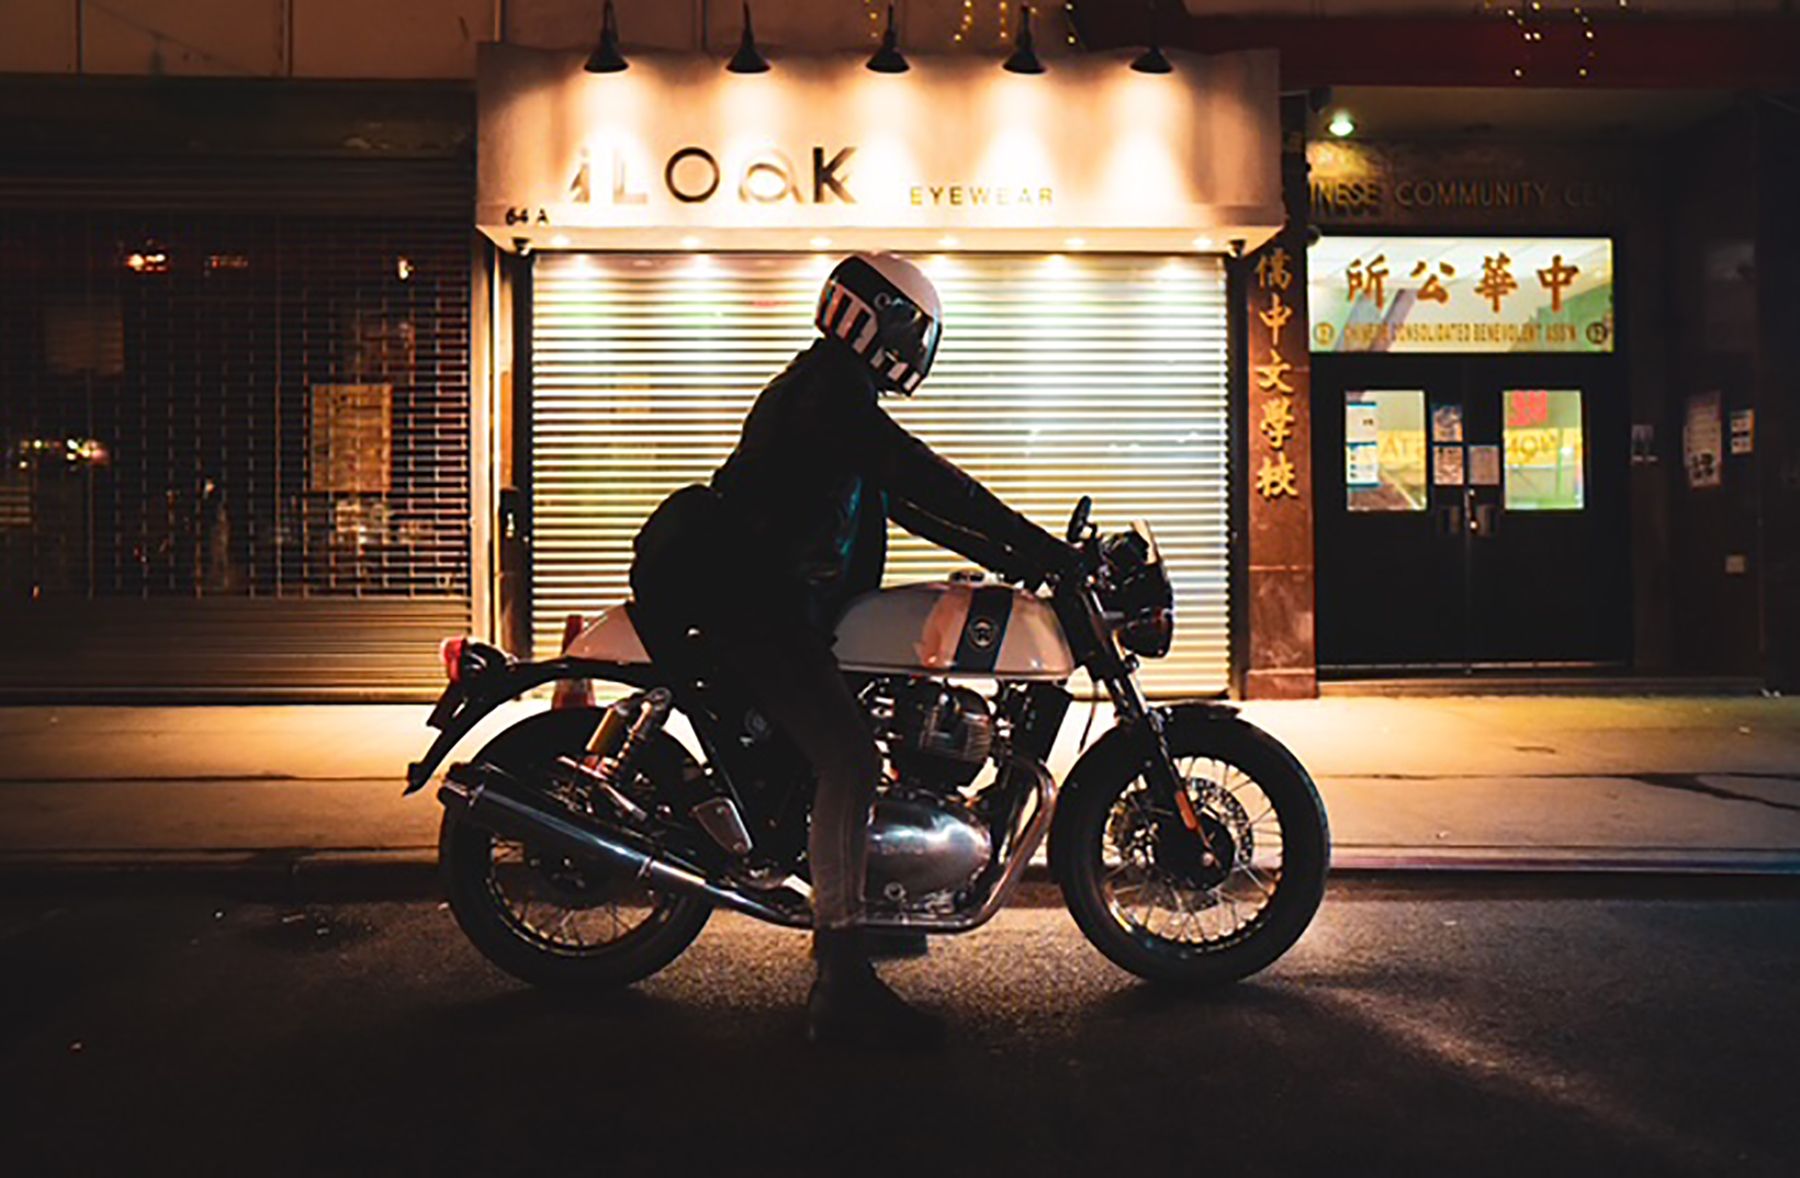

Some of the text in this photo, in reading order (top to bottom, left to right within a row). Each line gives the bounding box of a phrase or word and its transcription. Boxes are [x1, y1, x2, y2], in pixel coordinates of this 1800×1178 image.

[910, 186, 1054, 205] EYEWEAR
[1396, 181, 1548, 207] COMMUNITY
[505, 206, 550, 226] 64 A
